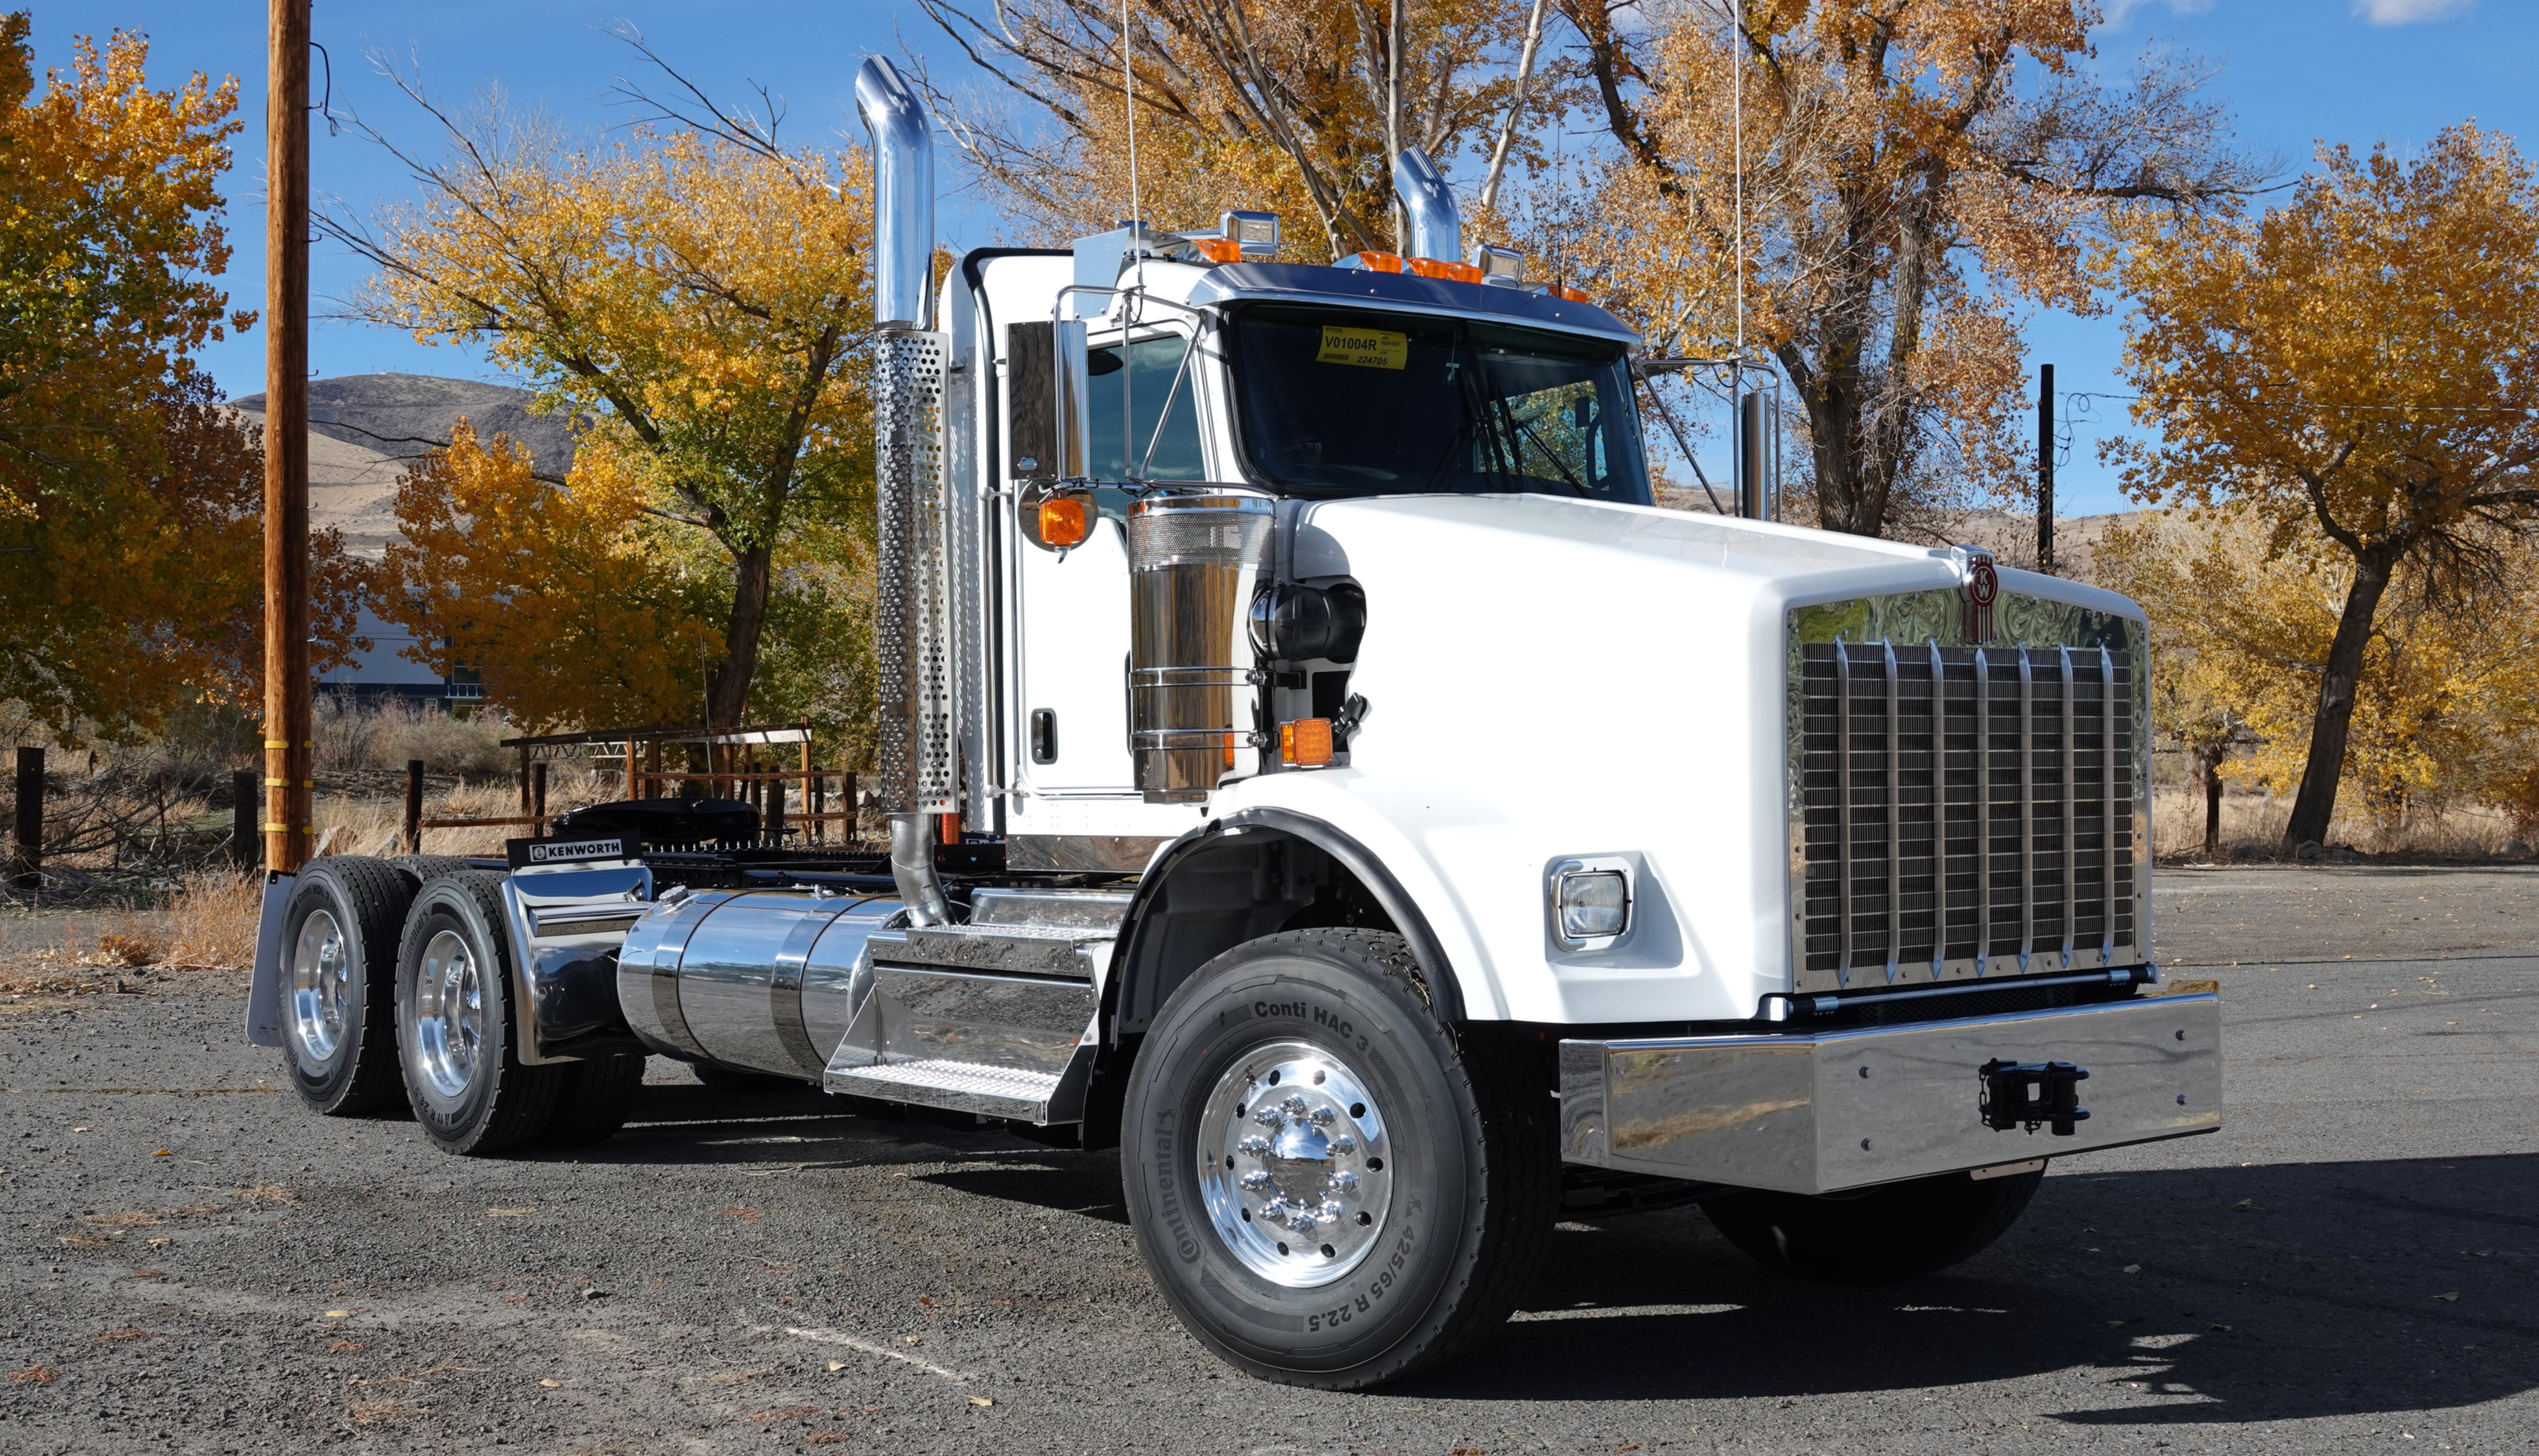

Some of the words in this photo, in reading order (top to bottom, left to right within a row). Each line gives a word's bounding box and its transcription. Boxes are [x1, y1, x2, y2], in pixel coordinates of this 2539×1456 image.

[1325, 336, 1377, 351] V01004R
[1356, 356, 1388, 365] 224705
[548, 843, 620, 857] KENWORTH
[297, 884, 311, 903] Conti
[313, 884, 325, 897] HDL
[1254, 1001, 1306, 1018] Conti
[1314, 1006, 1353, 1039] HAC
[1356, 1035, 1369, 1052] 3
[1155, 1127, 1201, 1264] Continental
[1370, 1224, 1415, 1301] 425/65
[1354, 1293, 1371, 1313] R
[1308, 1304, 1352, 1333] 22.5
